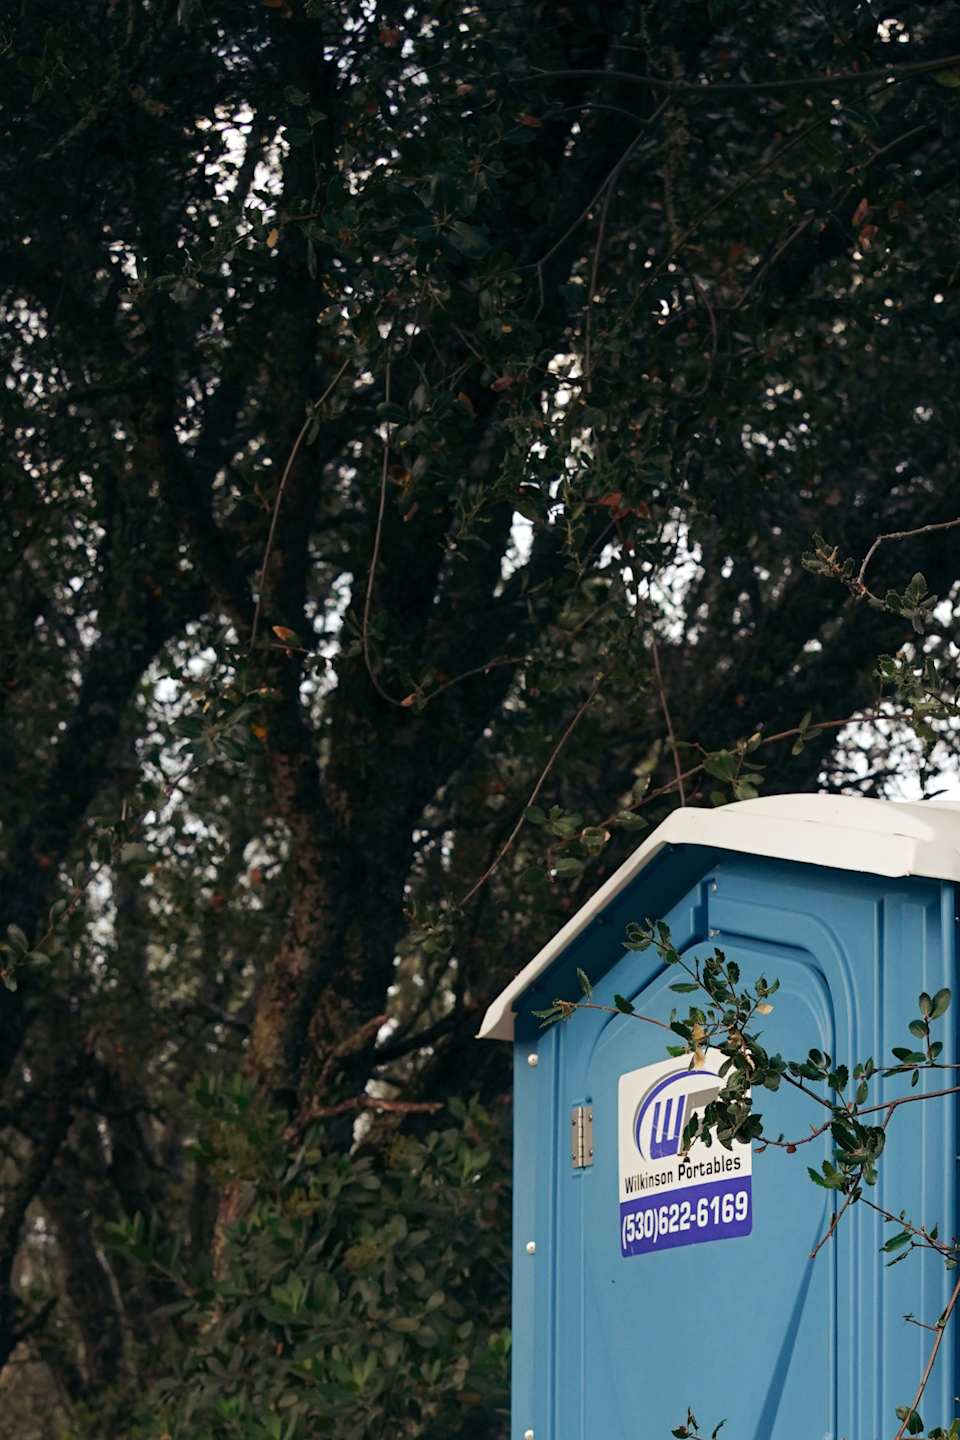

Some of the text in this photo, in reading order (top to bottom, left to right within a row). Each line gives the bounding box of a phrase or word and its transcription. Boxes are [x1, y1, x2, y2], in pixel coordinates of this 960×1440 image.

[625, 1155, 741, 1194] Wilkinson Portables
[622, 1190, 748, 1249] (530)622-6169
